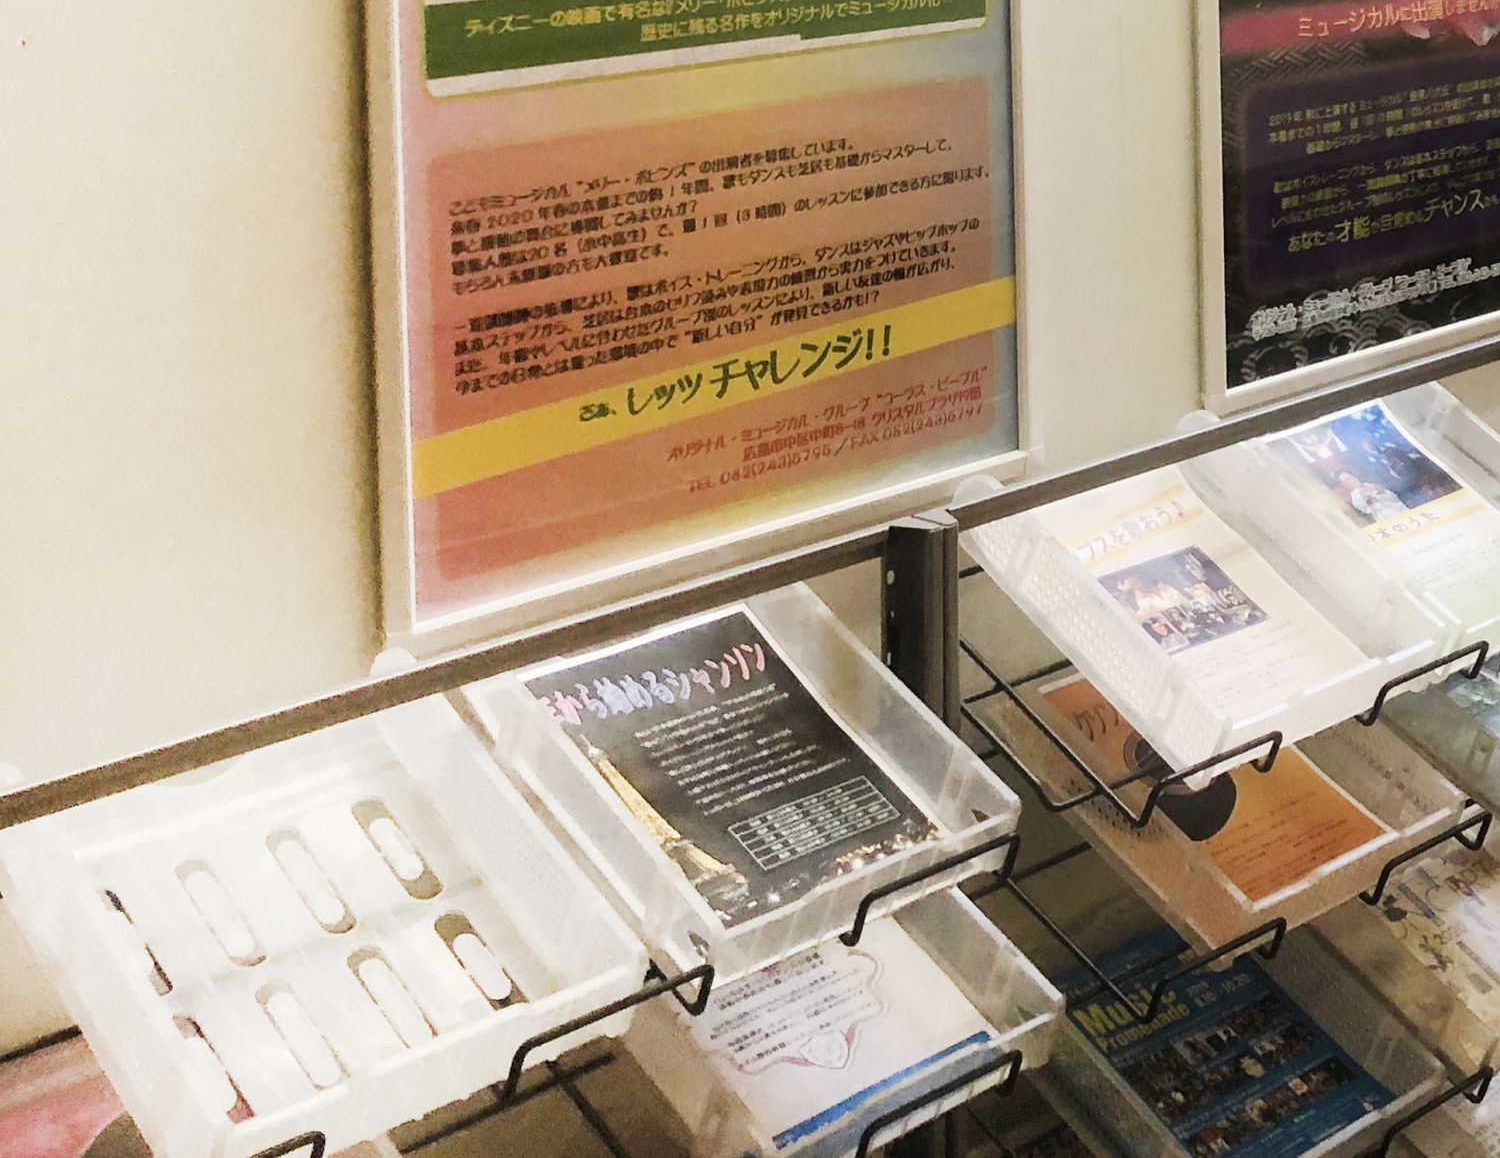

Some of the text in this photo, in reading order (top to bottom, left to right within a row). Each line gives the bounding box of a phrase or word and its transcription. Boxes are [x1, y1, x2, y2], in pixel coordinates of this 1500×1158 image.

[628, 373, 704, 417] レッツ
[710, 324, 891, 399] チャレンジ!!
